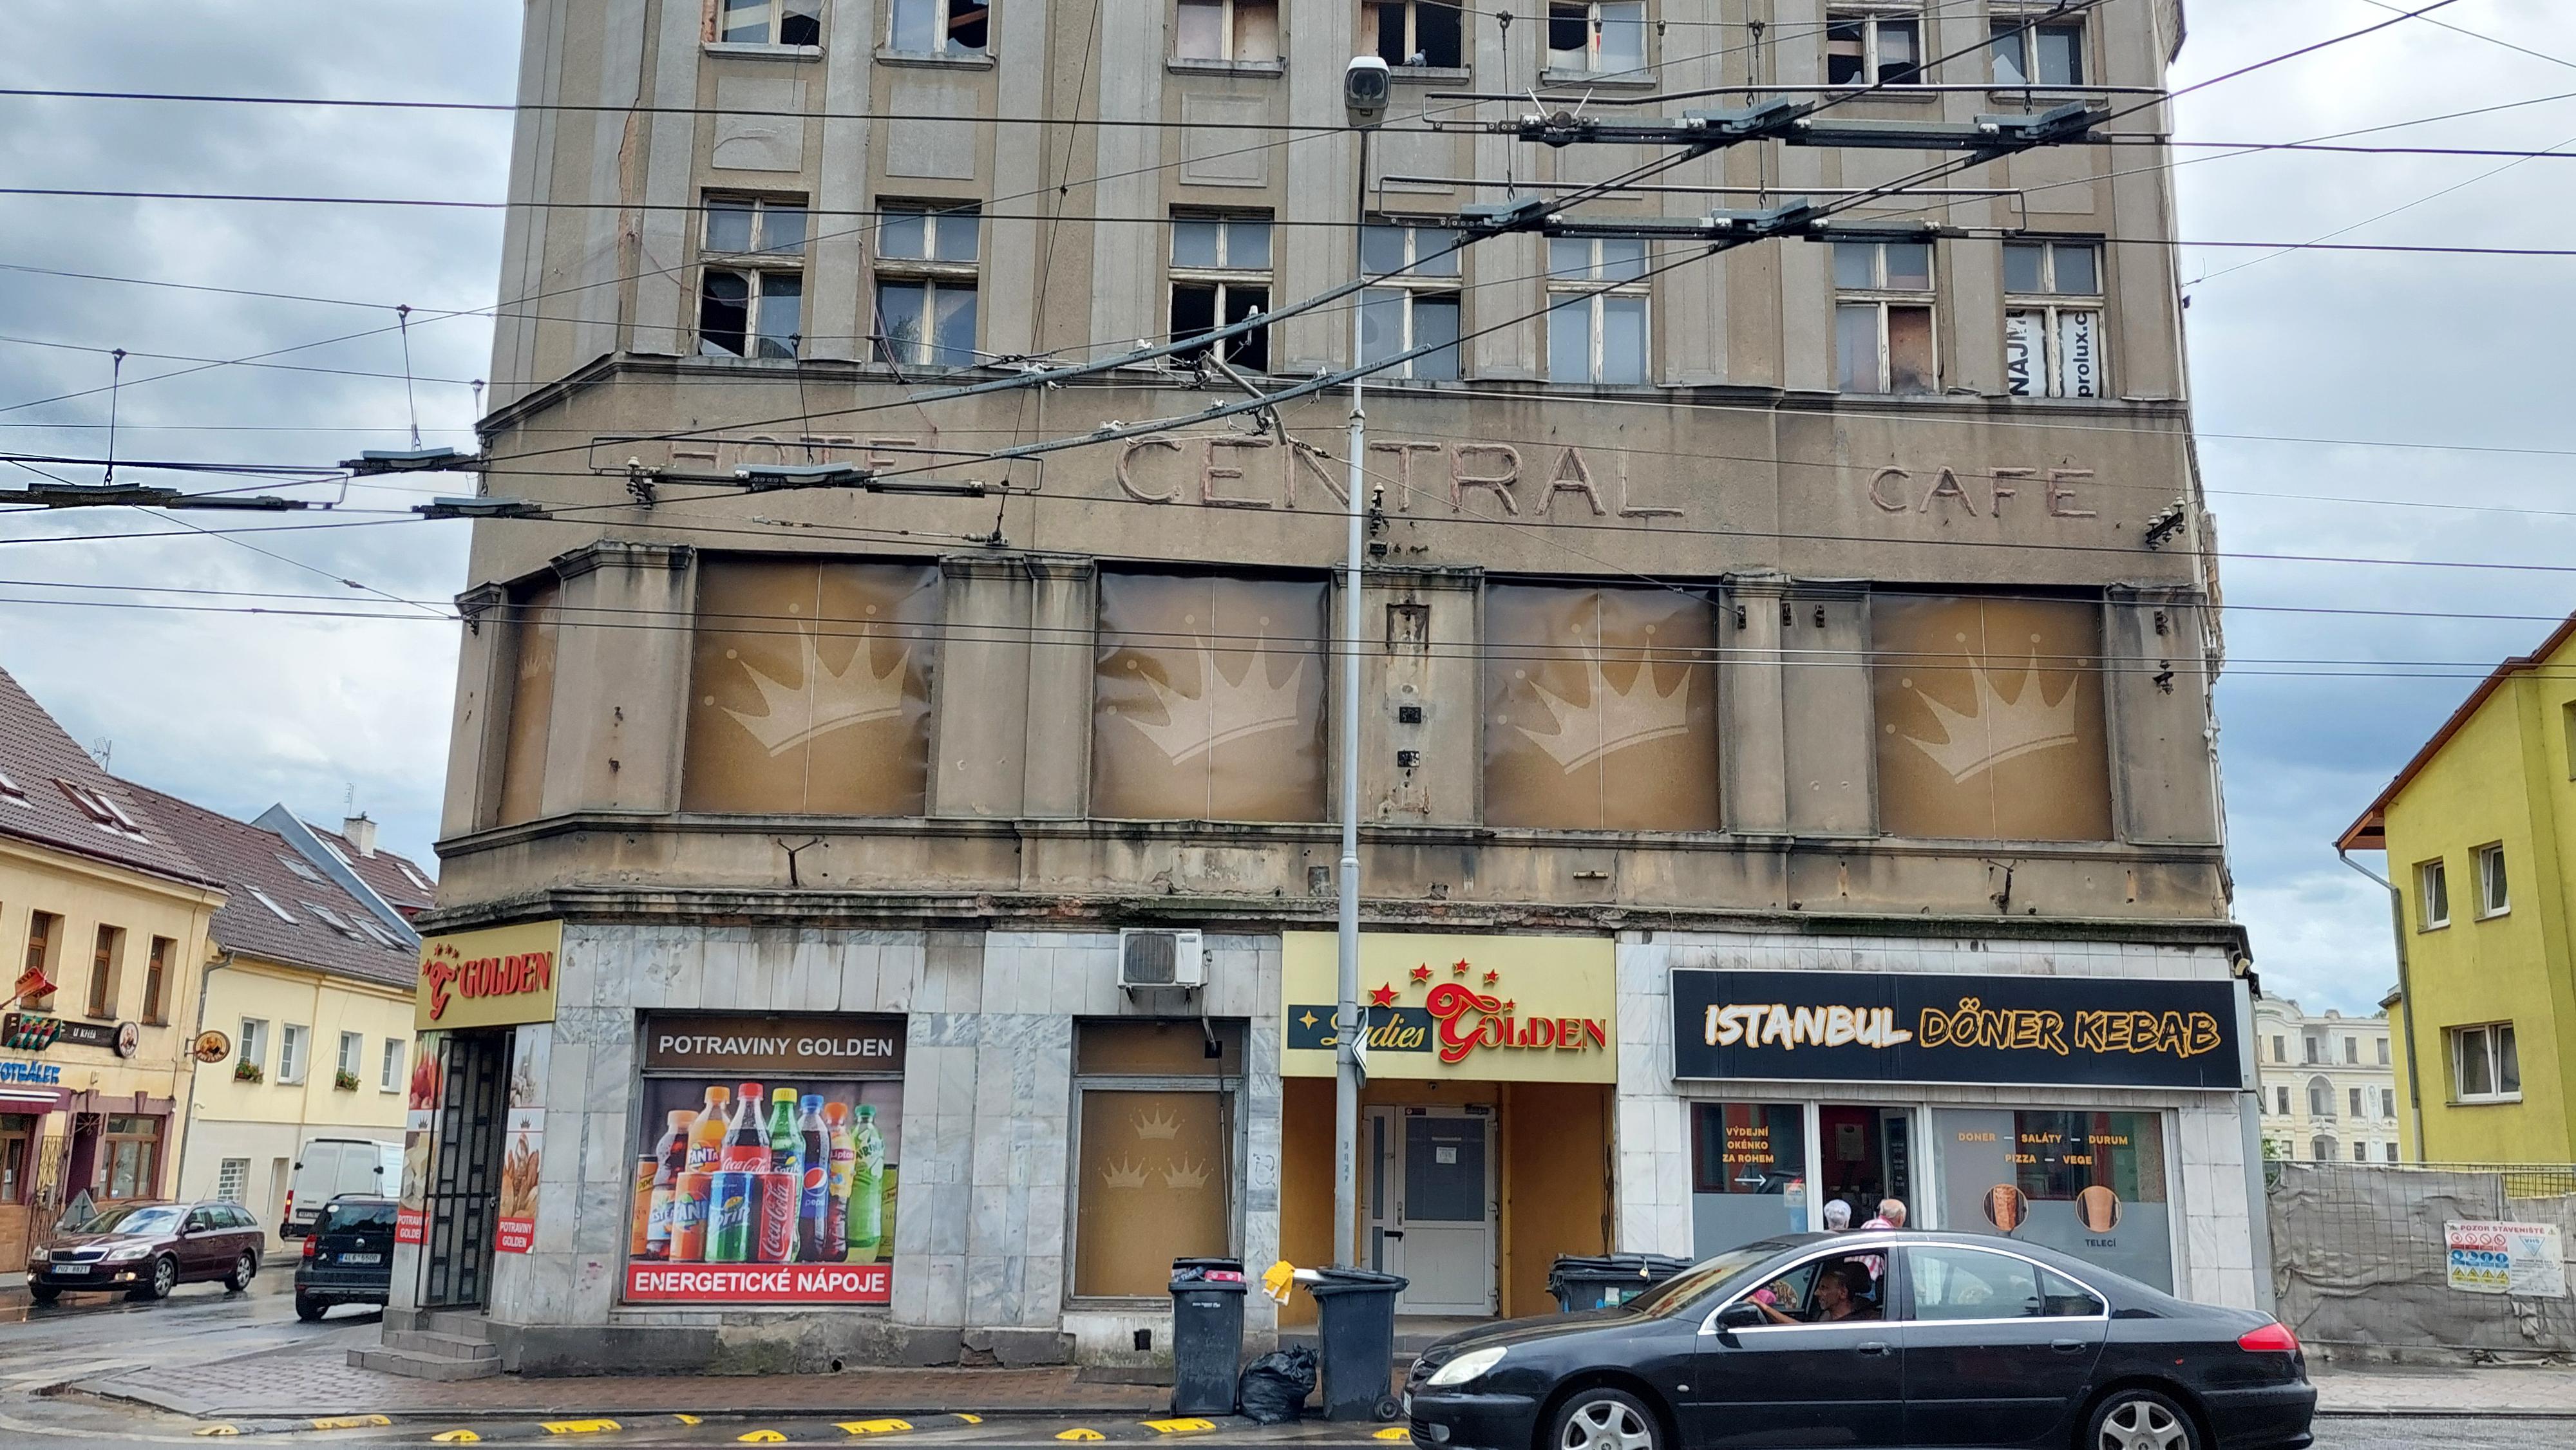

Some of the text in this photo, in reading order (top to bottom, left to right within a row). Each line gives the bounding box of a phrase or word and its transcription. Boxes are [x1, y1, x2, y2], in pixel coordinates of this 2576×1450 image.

[1115, 435, 1685, 517] CENTRAL
[459, 951, 553, 998] GOLDEN
[1426, 983, 1606, 1063] GOLDEN
[1705, 997, 2221, 1059] ISTANBUL DÖNER KEBAB
[659, 1035, 893, 1057] POTRAVINY GOLDEN
[1726, 1125, 1768, 1137] VÝDEJNÍ
[1727, 1139, 1768, 1150] OKÉNKO
[1958, 1132, 2128, 1145] DONER SALÁTY DURUM
[1722, 1154, 1774, 1163] ZA ROHEM
[2005, 1154, 2092, 1165] PIZZA VEGE
[500, 1221, 533, 1234] POTRAVINY
[502, 1236, 527, 1248] GOLDEN
[2085, 1238, 2117, 1247] TELECÍ
[635, 1267, 886, 1293] ENERGETICKÉ NÁPOJE
